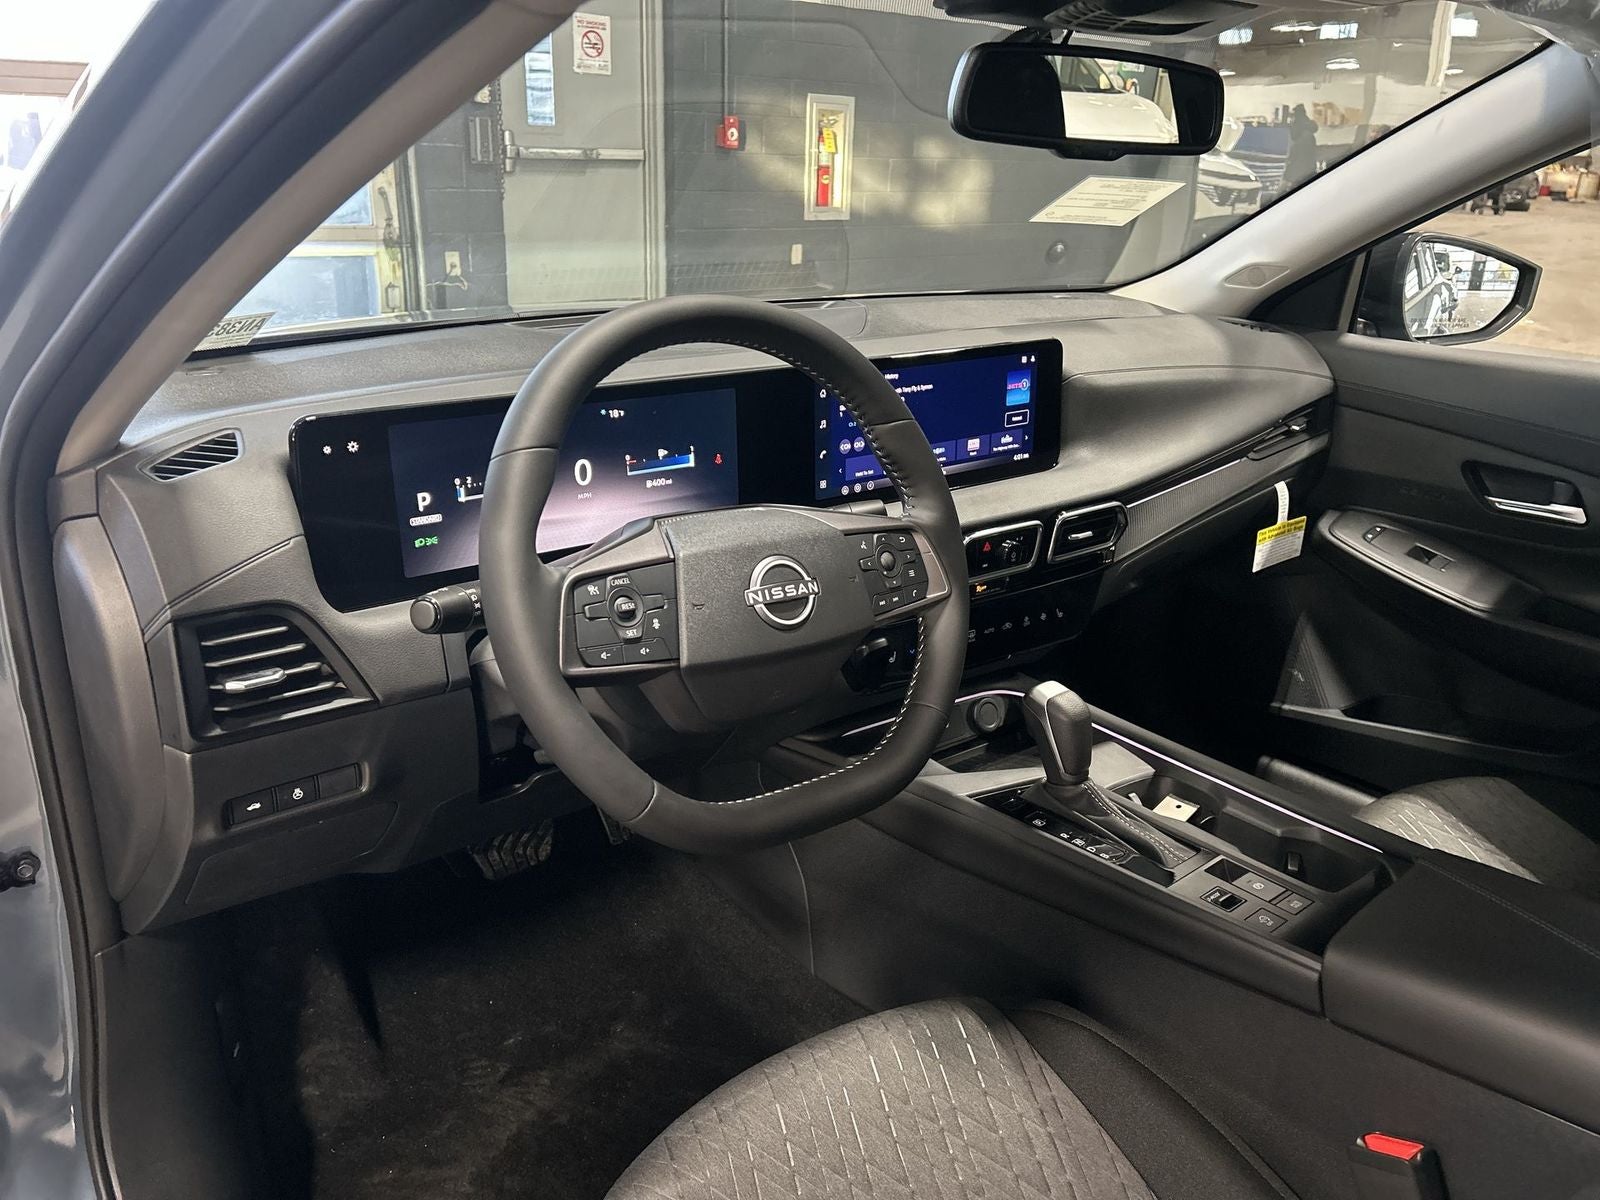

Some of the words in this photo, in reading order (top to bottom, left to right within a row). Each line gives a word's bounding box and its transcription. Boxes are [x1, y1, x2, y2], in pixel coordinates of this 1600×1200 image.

[574, 458, 592, 487] 0
[416, 492, 432, 512] P
[610, 578, 631, 586] CANCEL
[747, 581, 819, 605] NISSAN
[625, 629, 638, 637] SET
